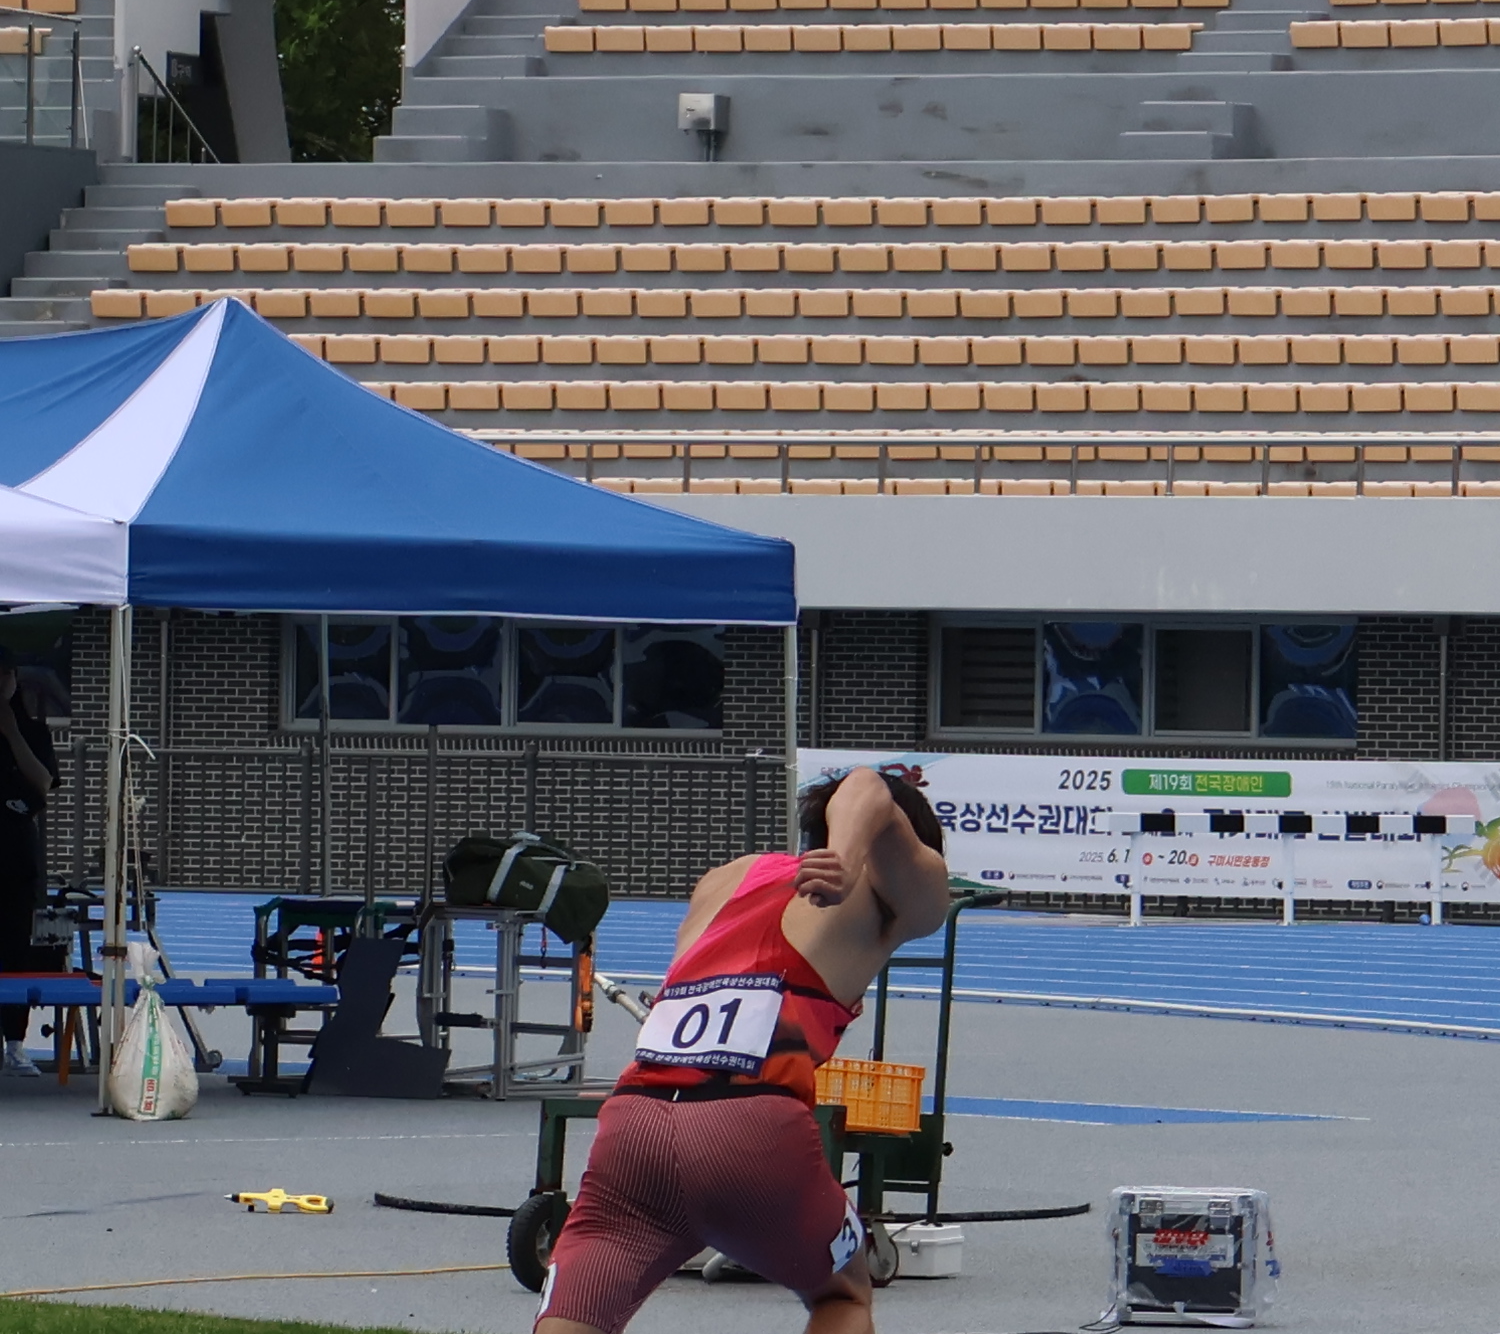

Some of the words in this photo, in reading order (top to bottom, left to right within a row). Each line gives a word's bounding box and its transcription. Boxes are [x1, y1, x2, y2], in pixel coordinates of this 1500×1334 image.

[1058, 769, 1112, 791] 2025
[1149, 773, 1192, 792] 제19회
[1194, 773, 1264, 793] 전국장애인
[671, 997, 742, 1049] 01
